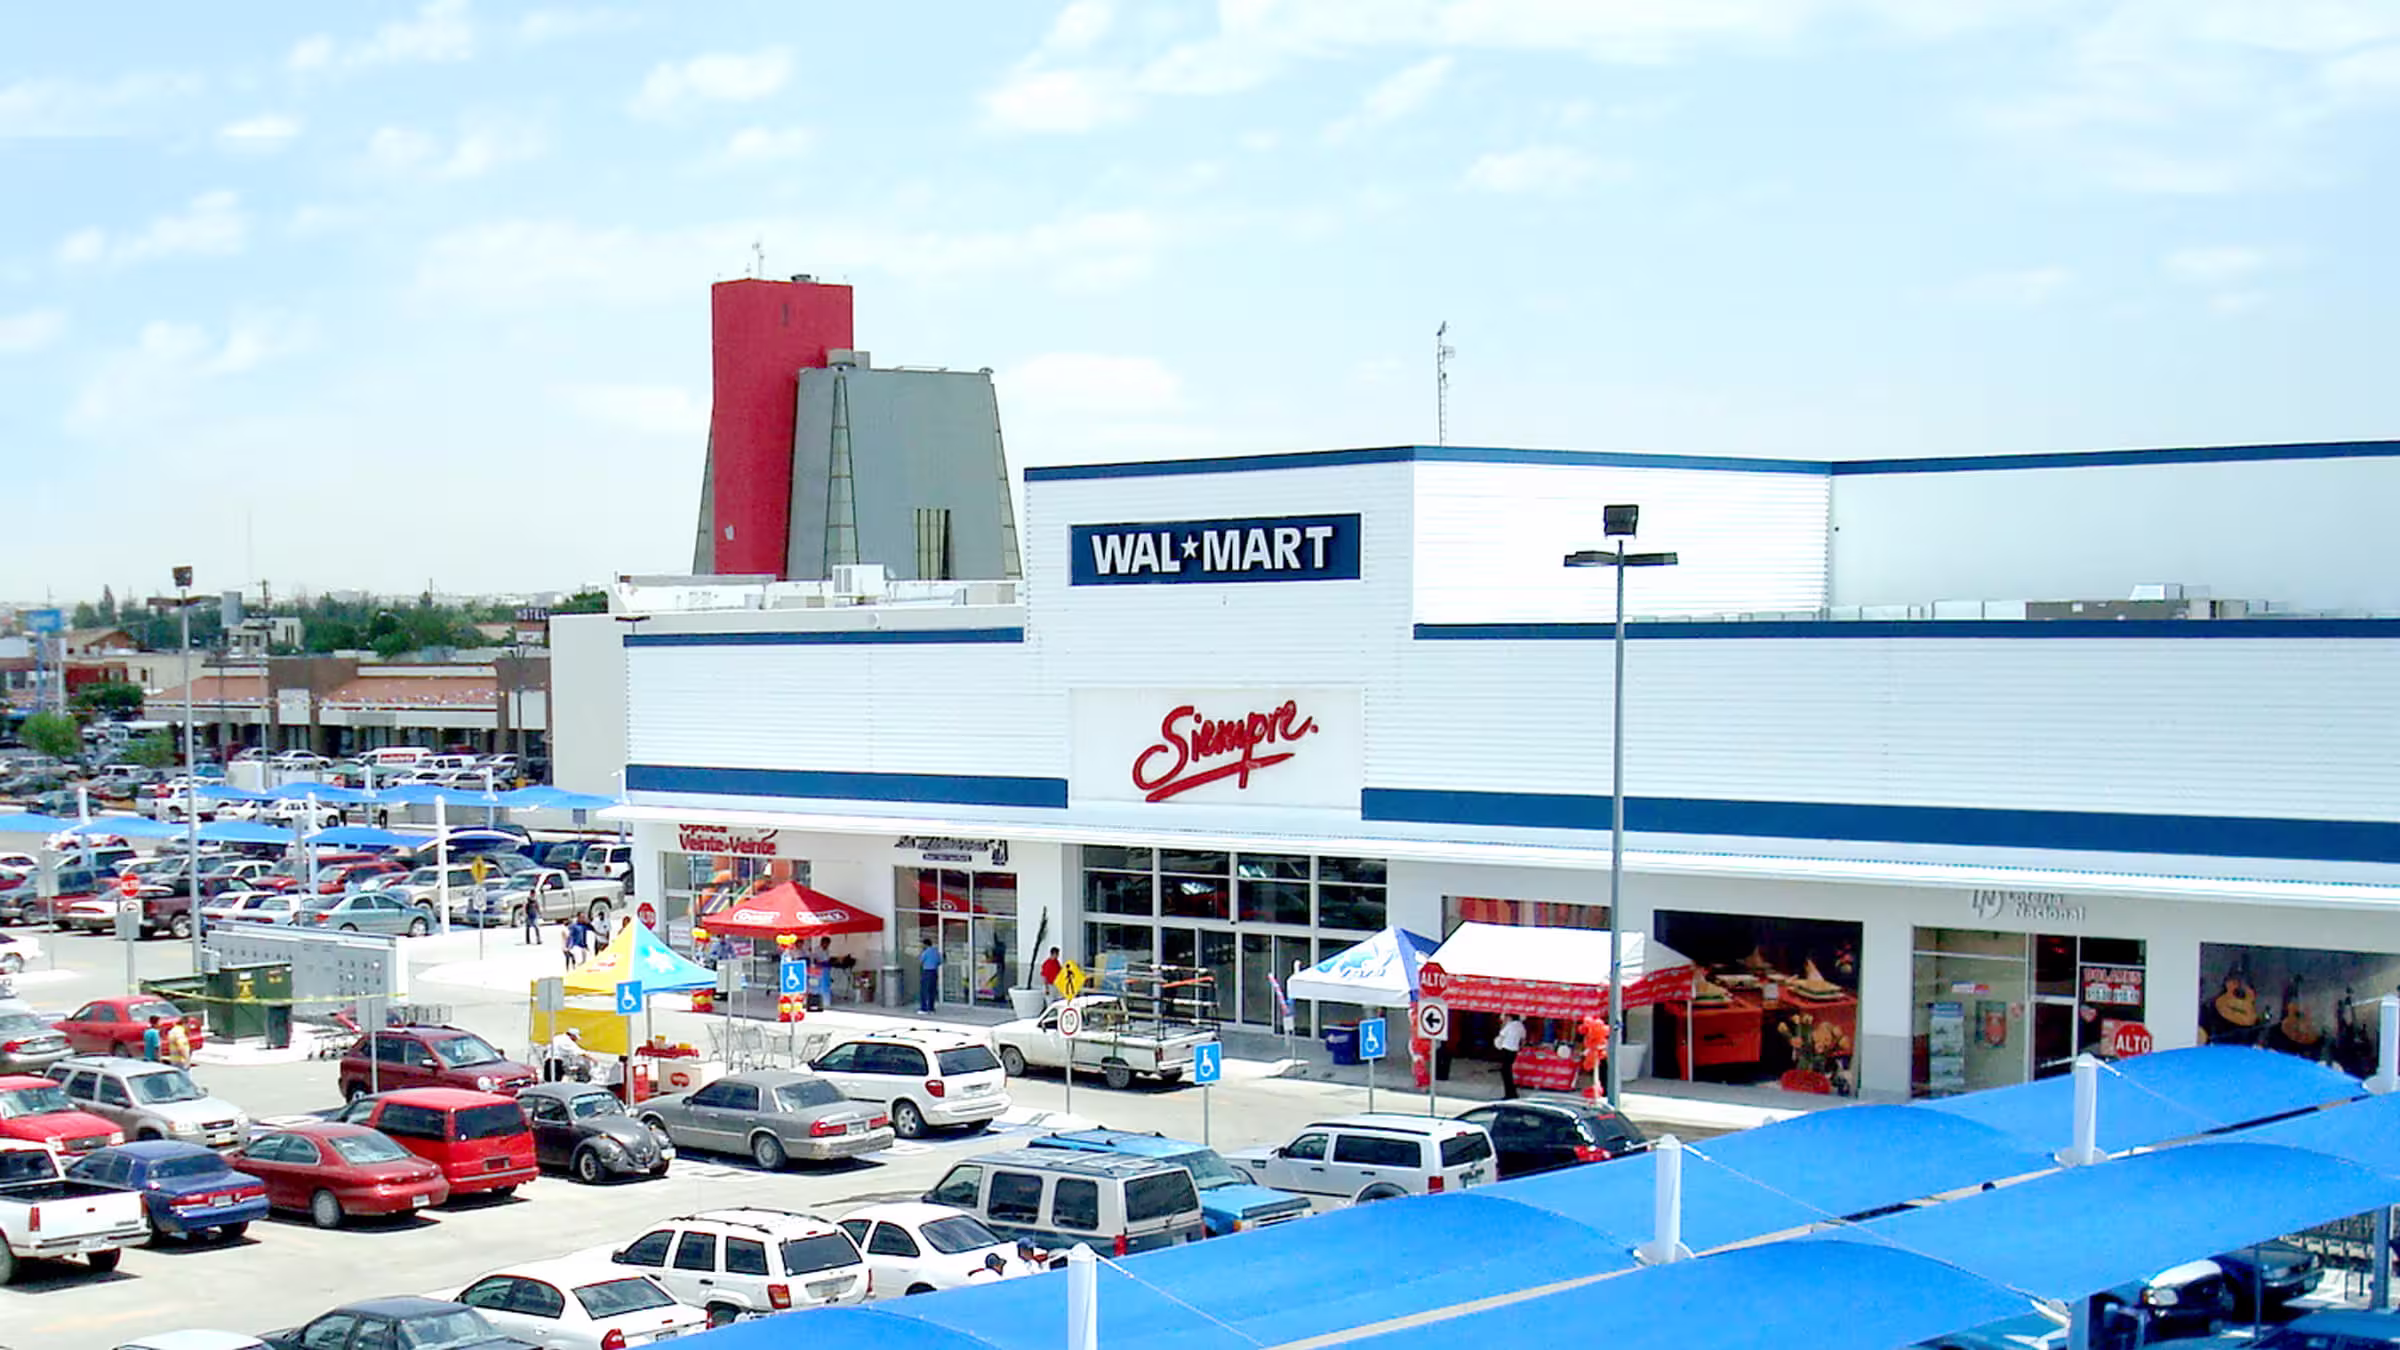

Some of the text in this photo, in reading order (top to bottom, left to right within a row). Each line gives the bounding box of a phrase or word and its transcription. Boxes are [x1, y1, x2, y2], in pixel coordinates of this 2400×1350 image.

[2015, 903, 2086, 921] Nacional
[1422, 971, 1447, 989] ALTO
[2116, 1033, 2151, 1054] ALTO
